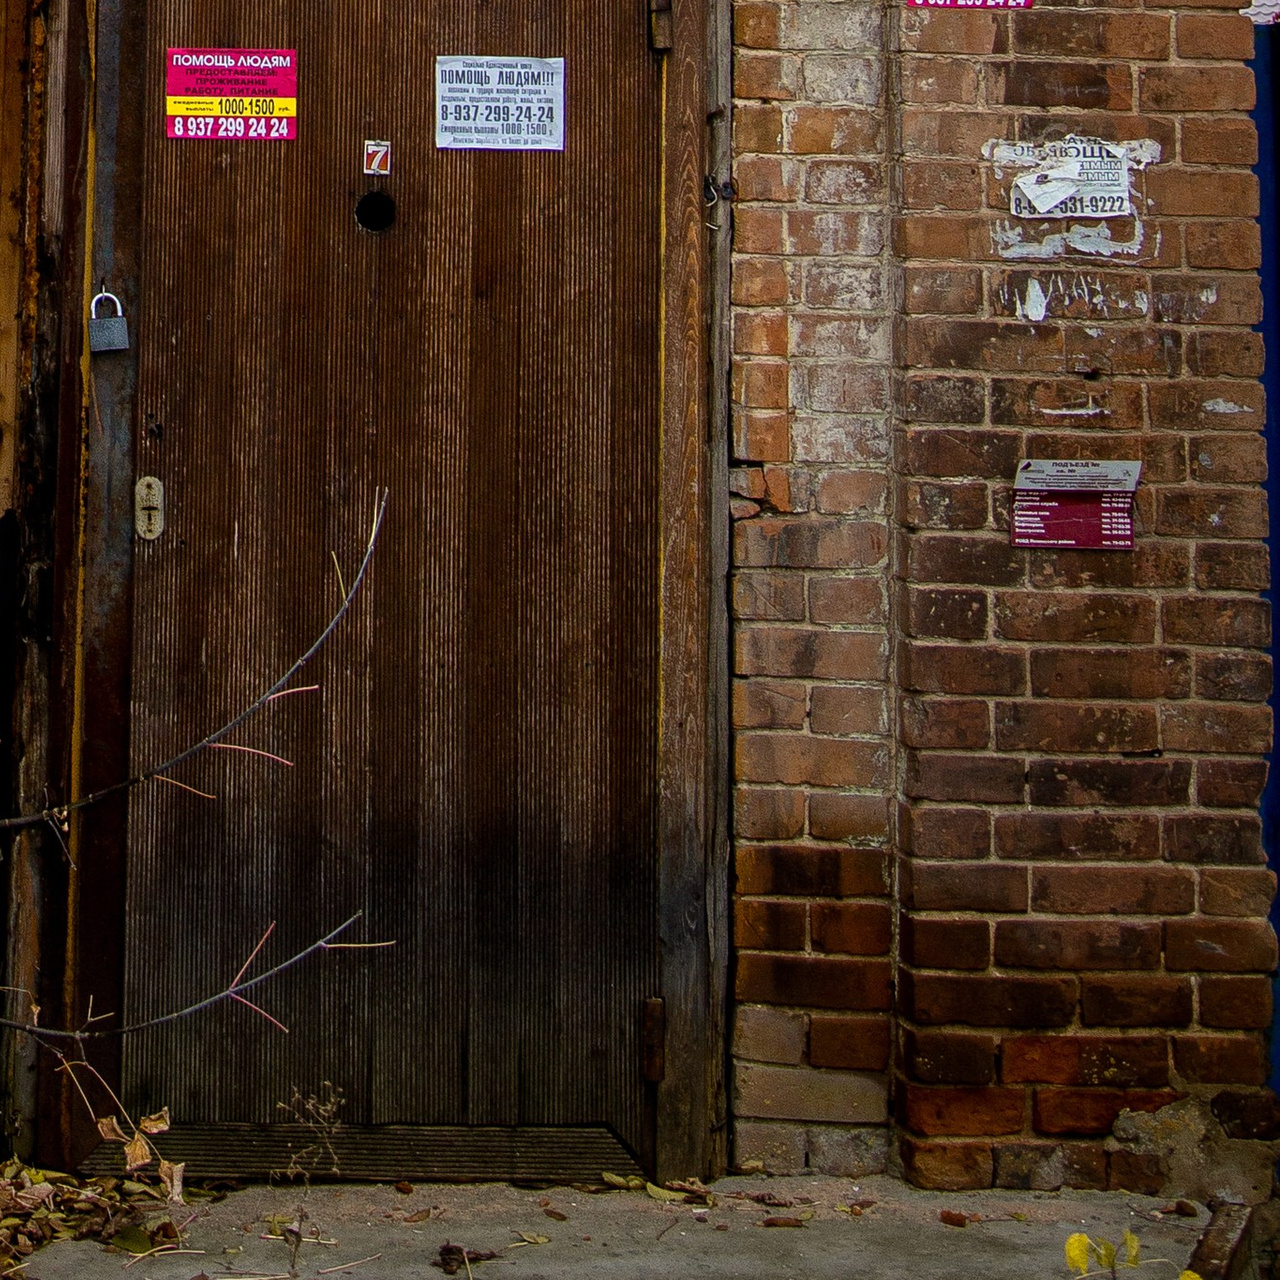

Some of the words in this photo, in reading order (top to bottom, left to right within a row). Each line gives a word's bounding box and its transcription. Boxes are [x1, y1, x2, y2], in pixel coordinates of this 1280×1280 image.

[173, 54, 236, 68] ПОМОЩЬ
[237, 55, 291, 69] ЛЮДЯМ
[195, 77, 268, 86] ПРОЖИВАНИЕ
[440, 69, 491, 86] ПОМОЩЬ
[496, 70, 554, 87] ЛЮДЯМ!!!
[184, 86, 227, 96] РАБОТУ,
[230, 87, 278, 96] ПИТАНИЕ
[218, 98, 275, 115] 1000-1500
[440, 104, 554, 123] 8-937-299-24-24
[174, 116, 184, 136] 8
[187, 116, 214, 137] 937
[217, 117, 244, 137] 299
[248, 118, 267, 137] 24
[270, 118, 289, 137] 24
[368, 145, 388, 170] 7
